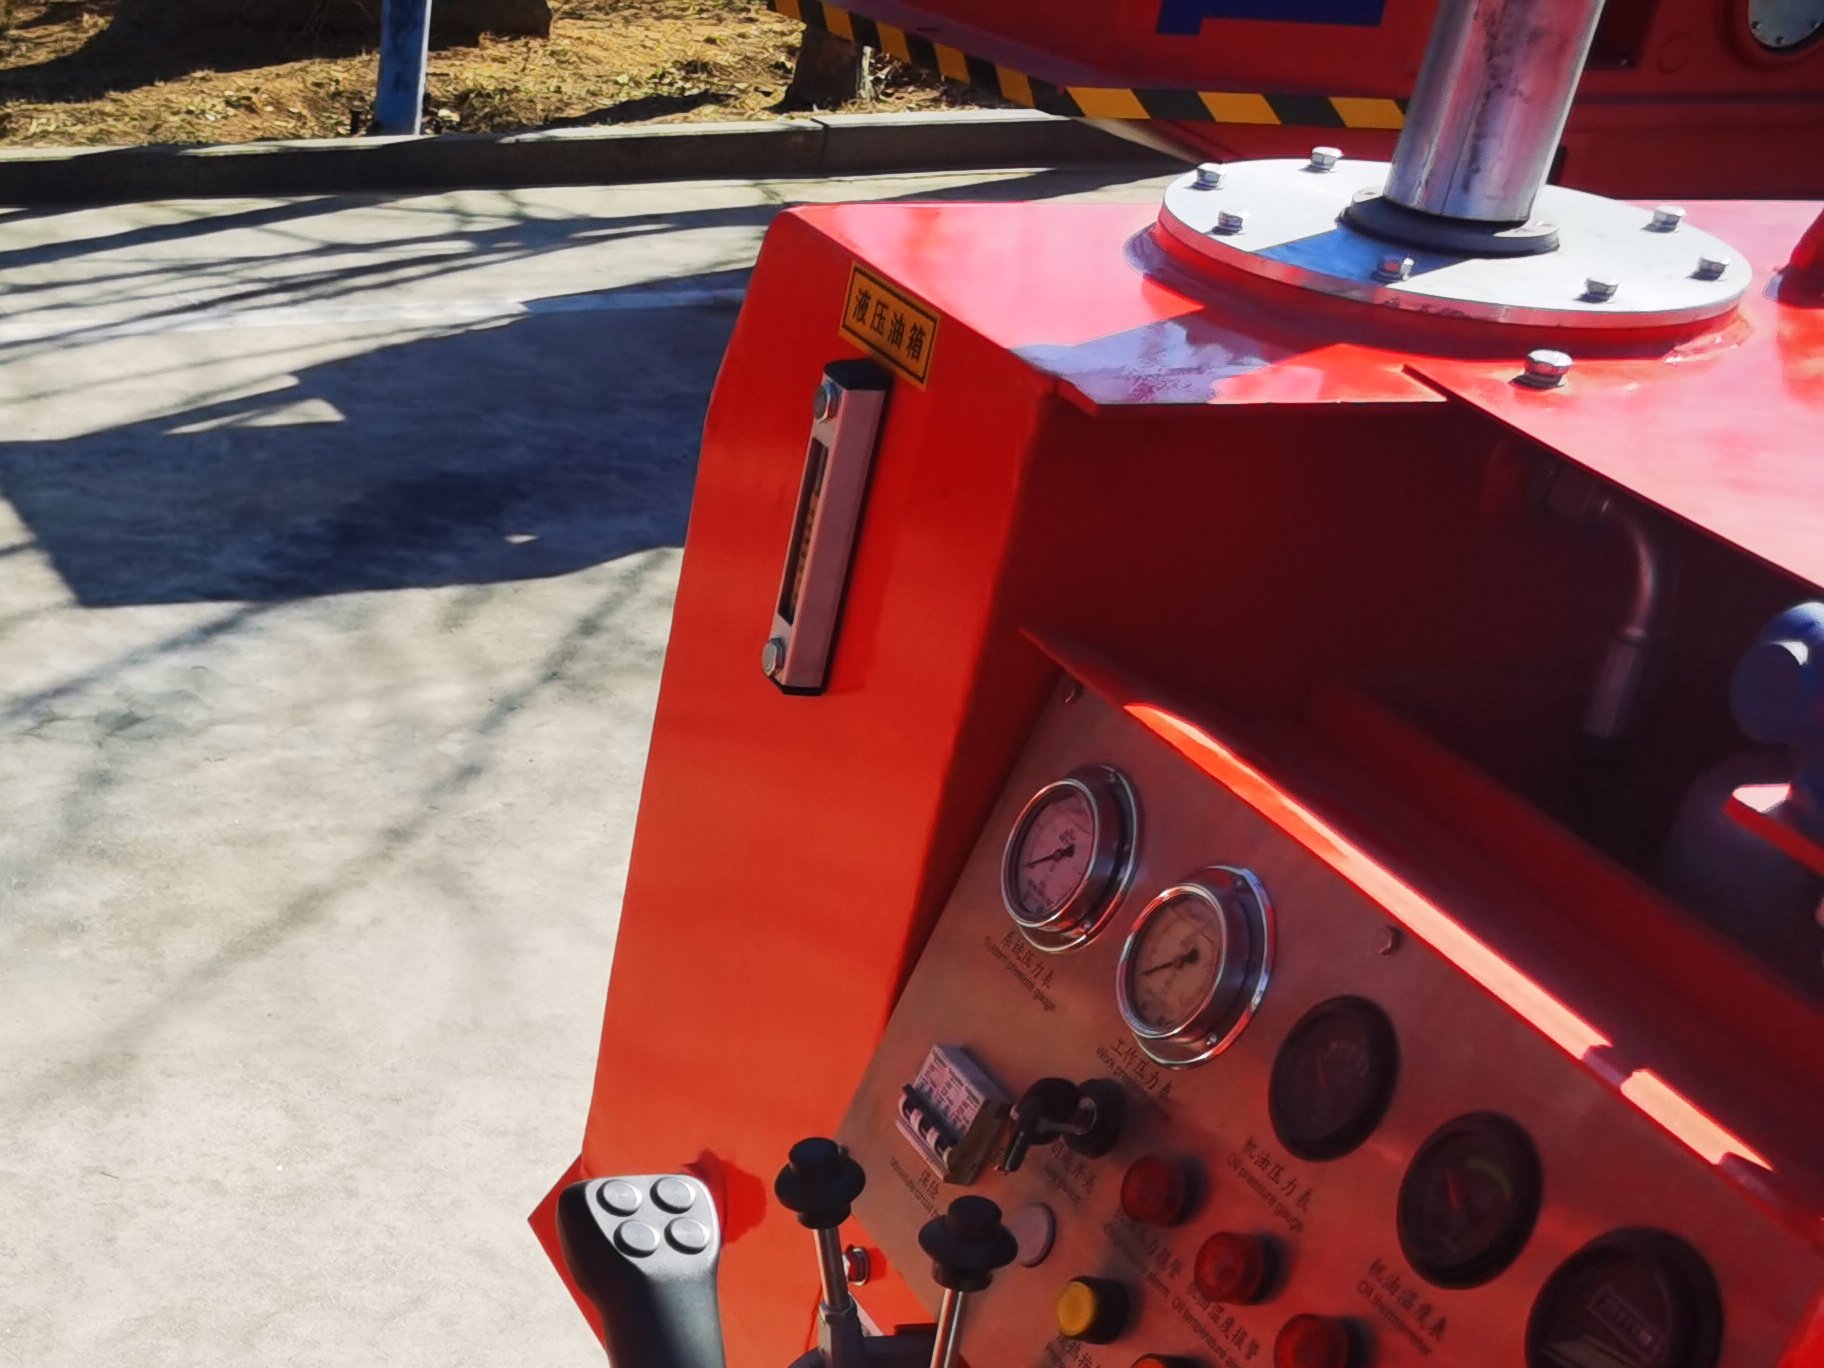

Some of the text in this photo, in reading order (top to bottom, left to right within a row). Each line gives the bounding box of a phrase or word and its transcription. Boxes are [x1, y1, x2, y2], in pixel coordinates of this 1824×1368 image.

[852, 287, 927, 361] 液压油箱
[1238, 1167, 1278, 1206] pressure
[1273, 1202, 1305, 1232] gauge
[1242, 1136, 1314, 1213] 机油压力表
[1183, 1309, 1227, 1360] temperature
[1356, 1279, 1433, 1357] Oil thermometer
[1368, 1256, 1448, 1343] 机油温度表
